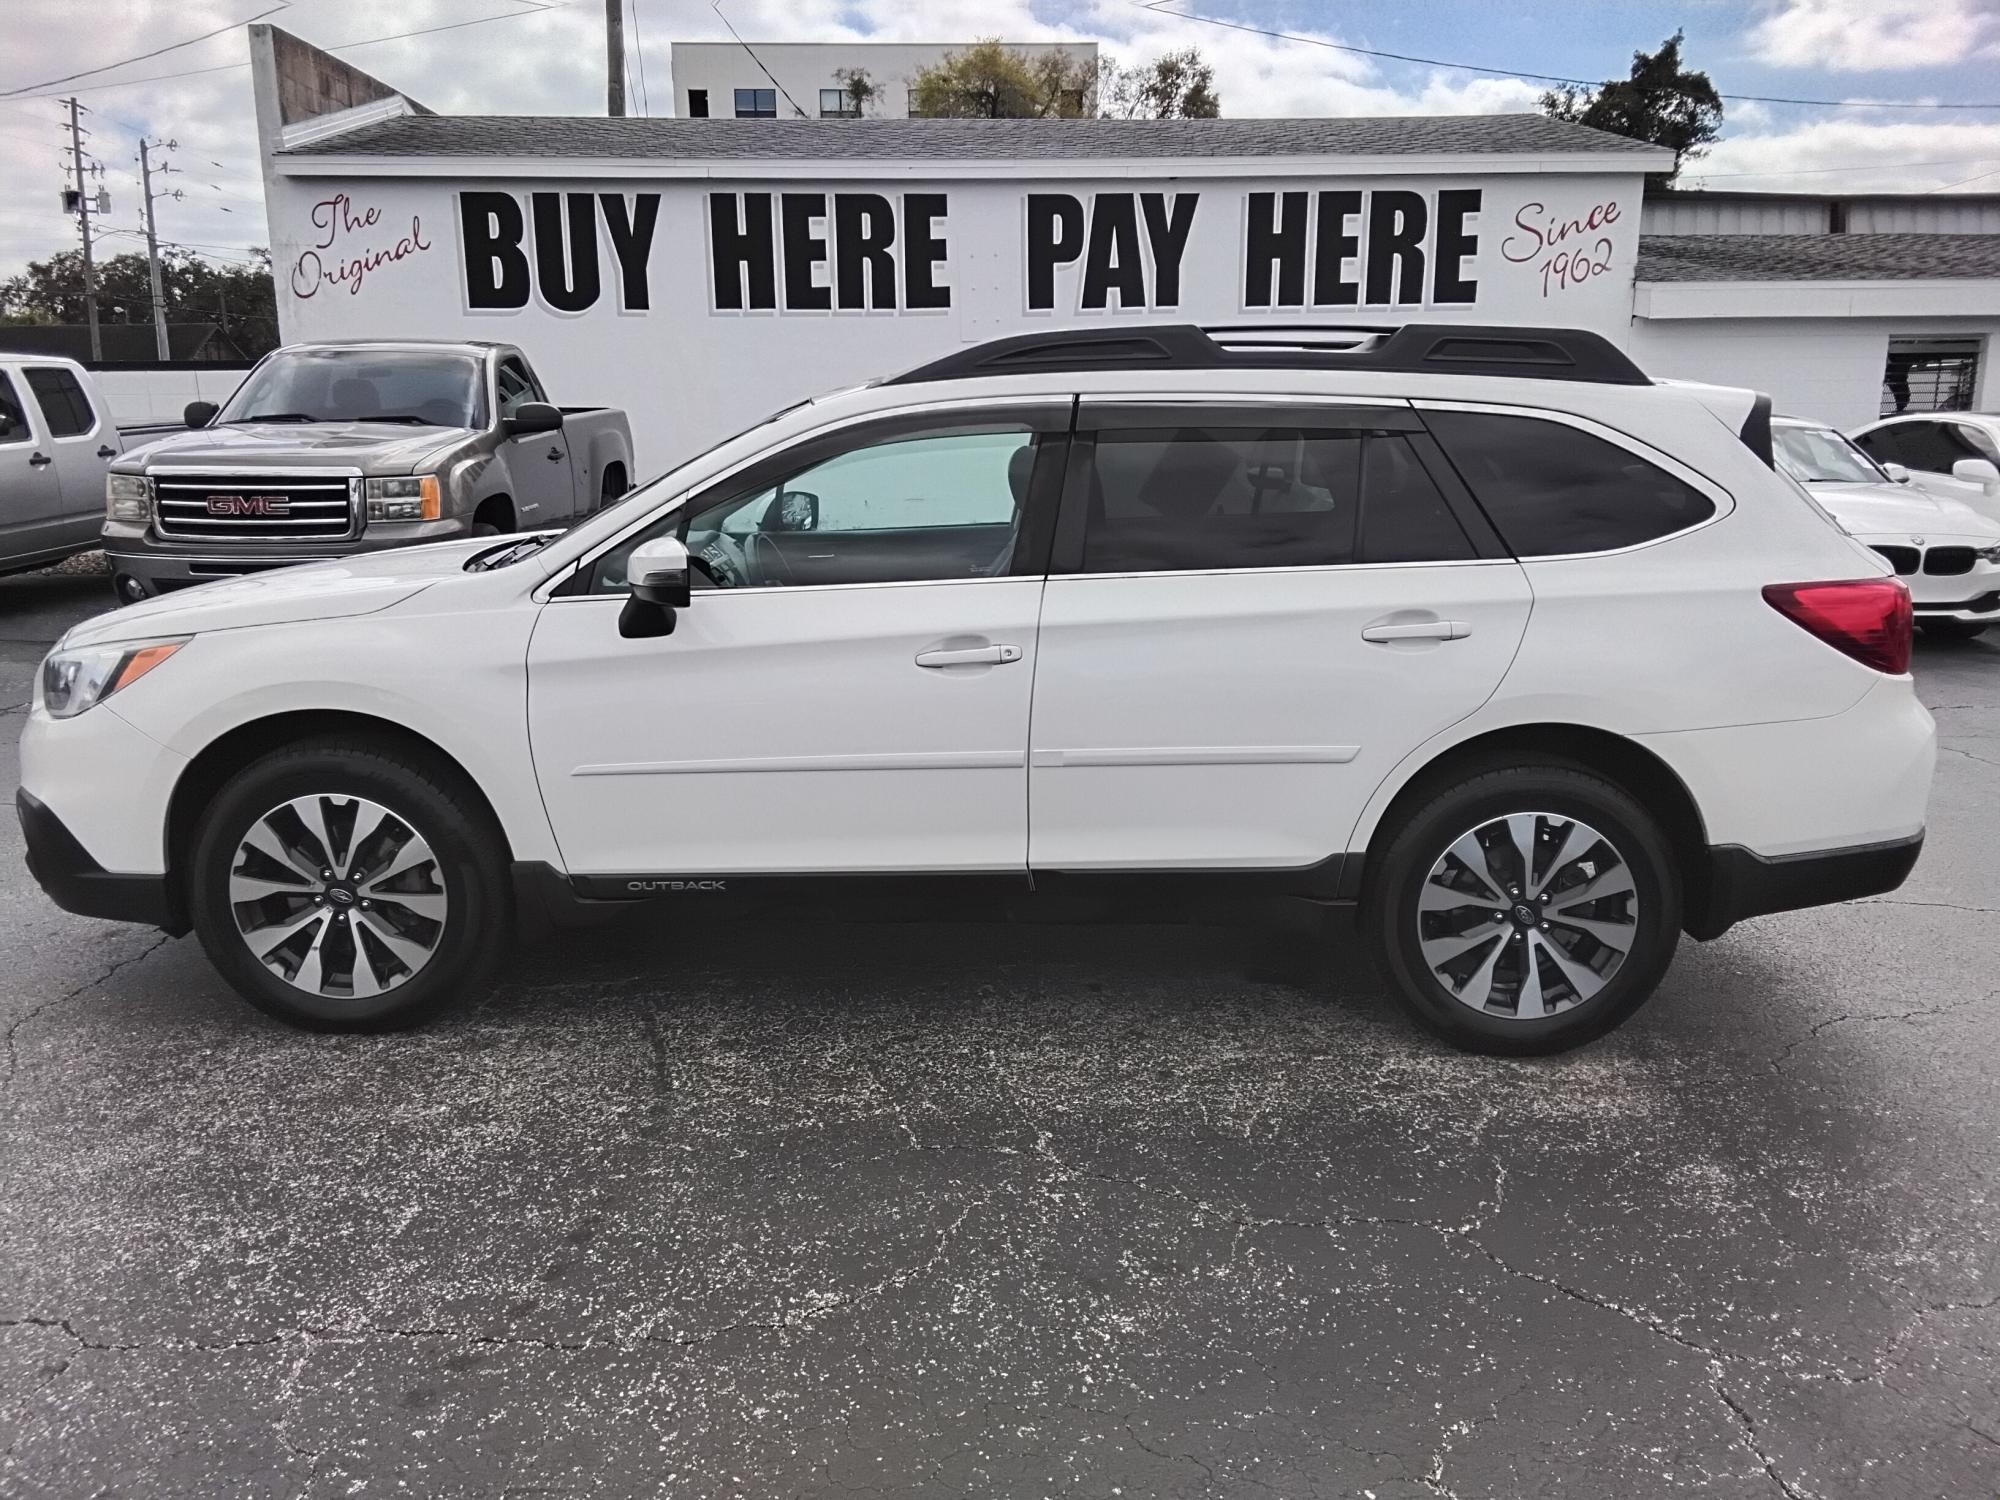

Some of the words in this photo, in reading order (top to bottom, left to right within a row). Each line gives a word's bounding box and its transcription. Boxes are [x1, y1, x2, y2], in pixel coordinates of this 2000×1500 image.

[312, 194, 382, 249] The
[458, 191, 662, 312] BUY
[708, 192, 951, 310] HERE
[1026, 192, 1201, 310] PAY
[1243, 188, 1483, 308] HERE
[1501, 201, 1621, 263] Since
[291, 215, 432, 299] Original
[1539, 237, 1613, 298] 1962
[206, 495, 290, 515] GMC
[626, 880, 726, 891] OUTBACK
